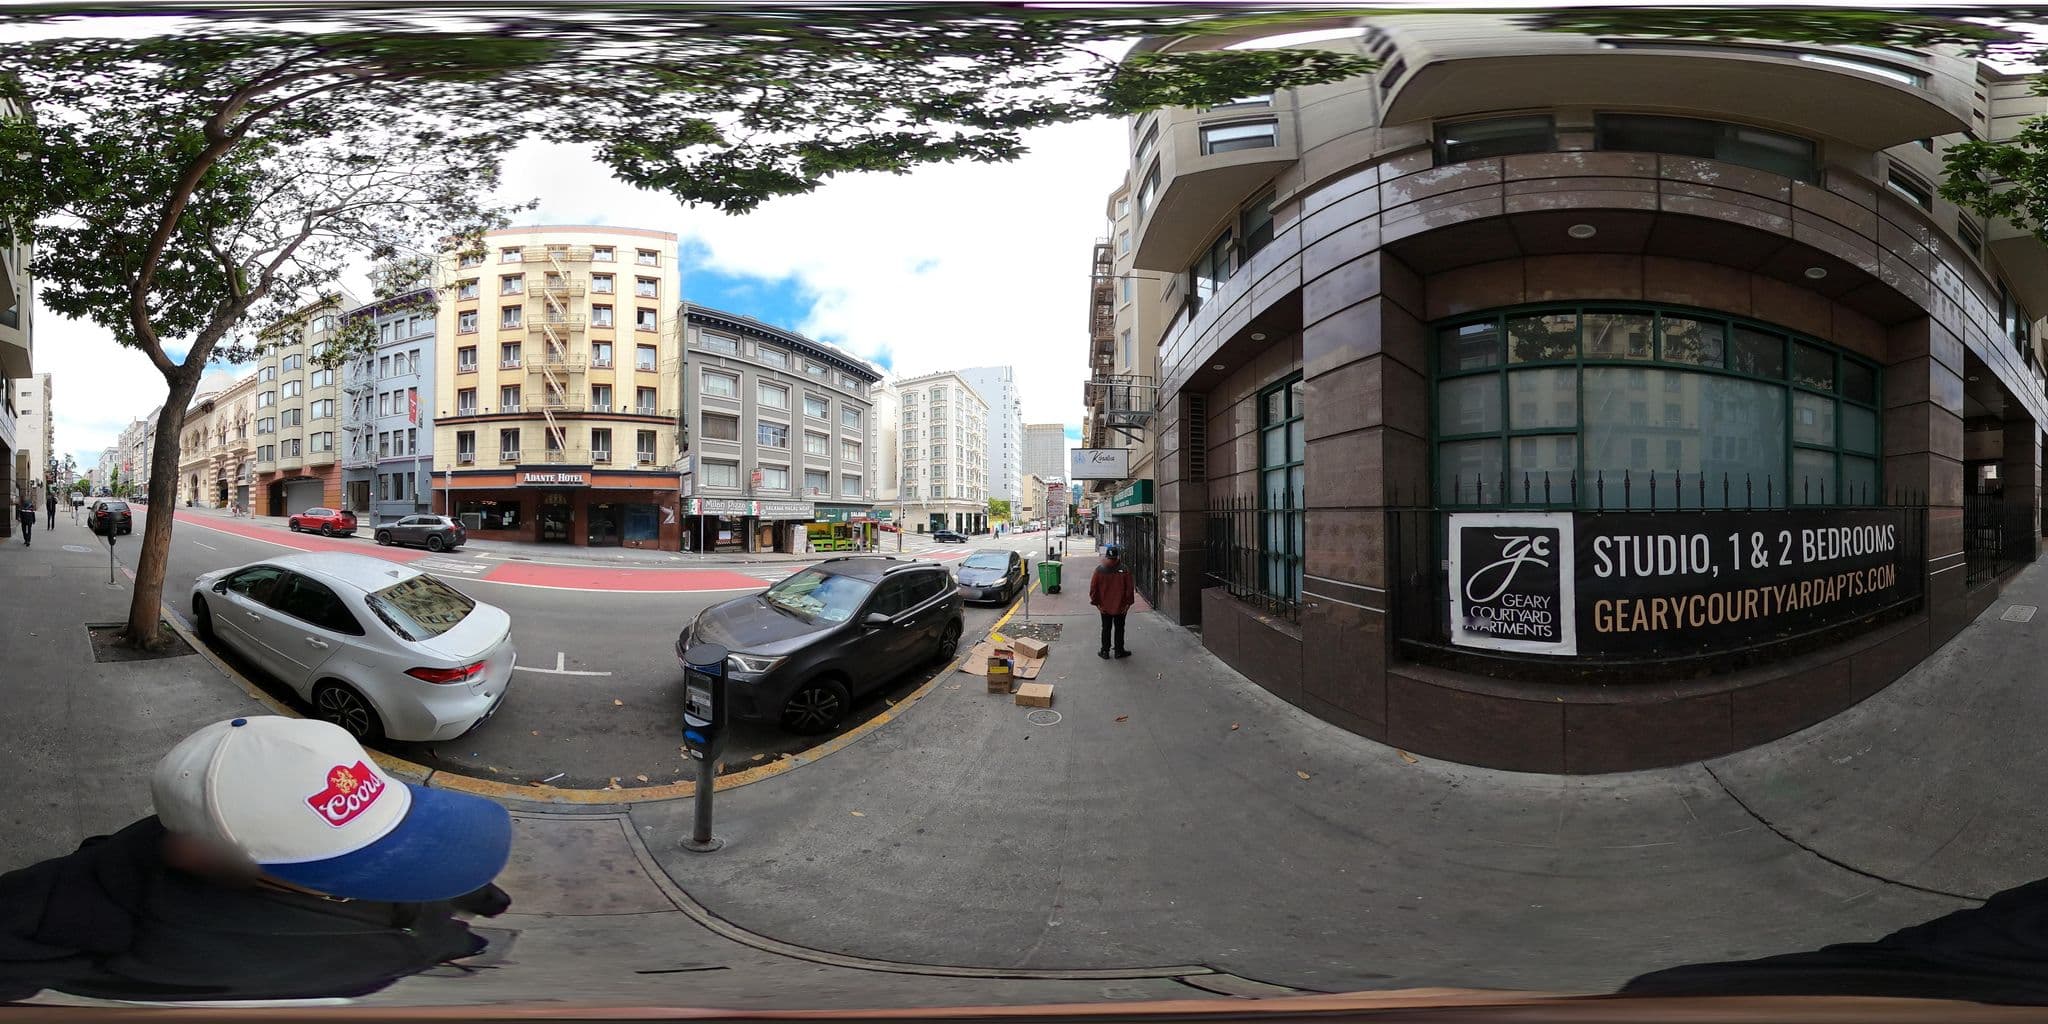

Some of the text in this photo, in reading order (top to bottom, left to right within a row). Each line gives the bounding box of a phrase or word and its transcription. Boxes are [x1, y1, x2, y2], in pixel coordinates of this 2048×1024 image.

[524, 473, 583, 482] ADANTE HOTEL
[1593, 524, 1895, 578] STUDIO, 1 & 2 BEDROOMS
[1502, 593, 1551, 609] GEARY
[1594, 563, 1895, 633] GEARYCOURTYARDAPTS.COM
[1470, 606, 1552, 624] COURTYARD
[1464, 620, 1553, 637] ARTMENTS
[318, 774, 383, 820] Coors
